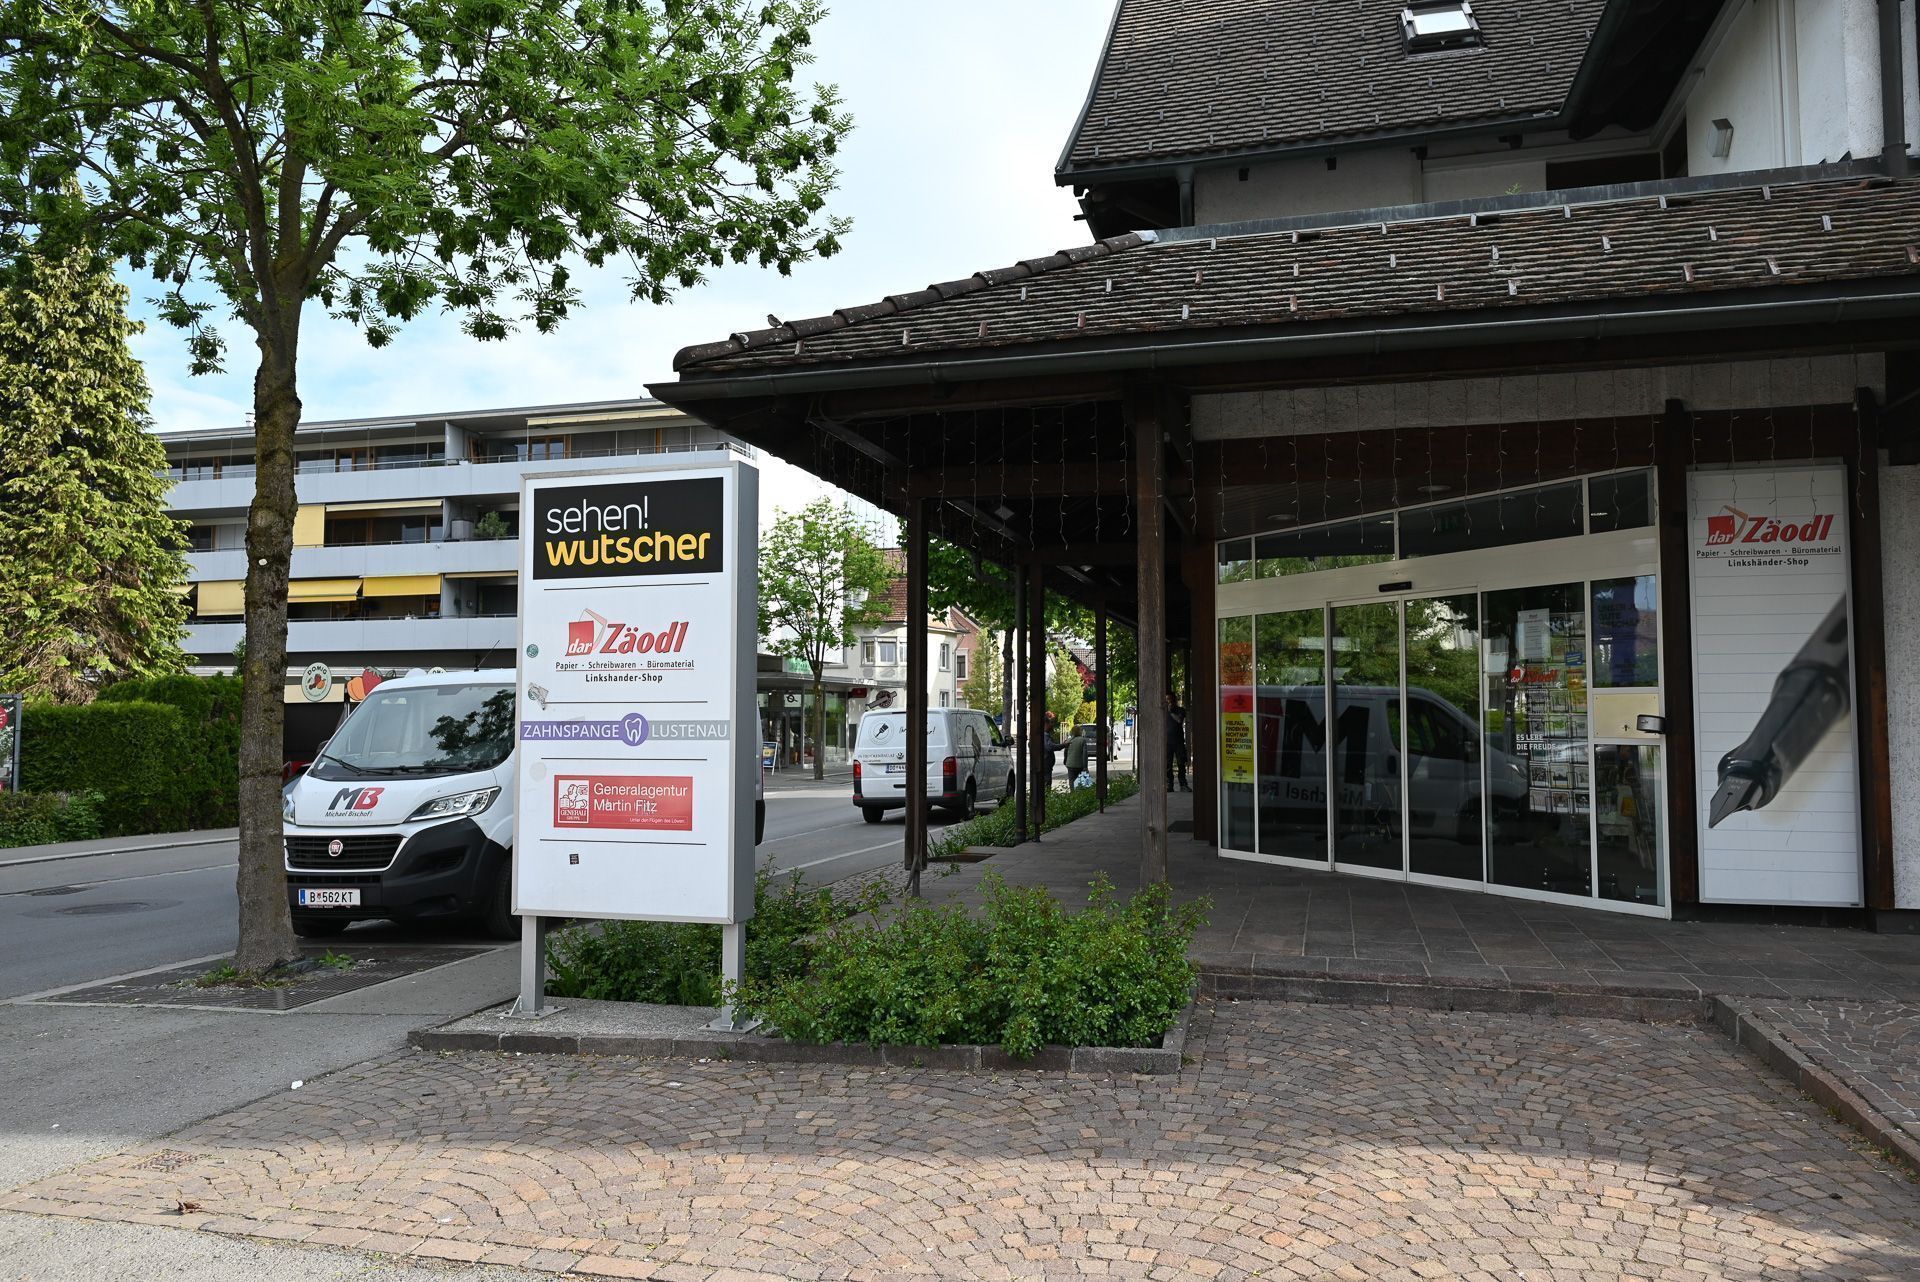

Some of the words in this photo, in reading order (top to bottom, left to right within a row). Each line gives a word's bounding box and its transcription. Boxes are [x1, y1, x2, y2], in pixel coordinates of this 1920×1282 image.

[546, 495, 649, 534] sehen!
[1708, 530, 1733, 544] dar
[1741, 514, 1834, 543] Zäodl
[545, 531, 711, 567] wutscher
[1696, 550, 1719, 558] Papier
[1730, 548, 1781, 556] Schreibwaren
[1791, 546, 1842, 554] Büromaterial
[1728, 558, 1809, 567] Linkshänder-Shop
[568, 638, 593, 654] dar
[599, 621, 690, 654] Zäodl
[307, 666, 327, 676] DOMIG
[555, 661, 578, 671] Papier
[588, 660, 636, 669] Schreibwaren
[647, 659, 695, 669] Büromaterial
[523, 724, 620, 738] ZAHNSPANGE
[651, 723, 728, 738] LUSTENAU
[594, 783, 688, 798] Generalagentur
[328, 787, 385, 810] MB
[593, 799, 632, 812] Martin
[635, 799, 658, 812] Fitz
[560, 809, 587, 817] GENERALI
